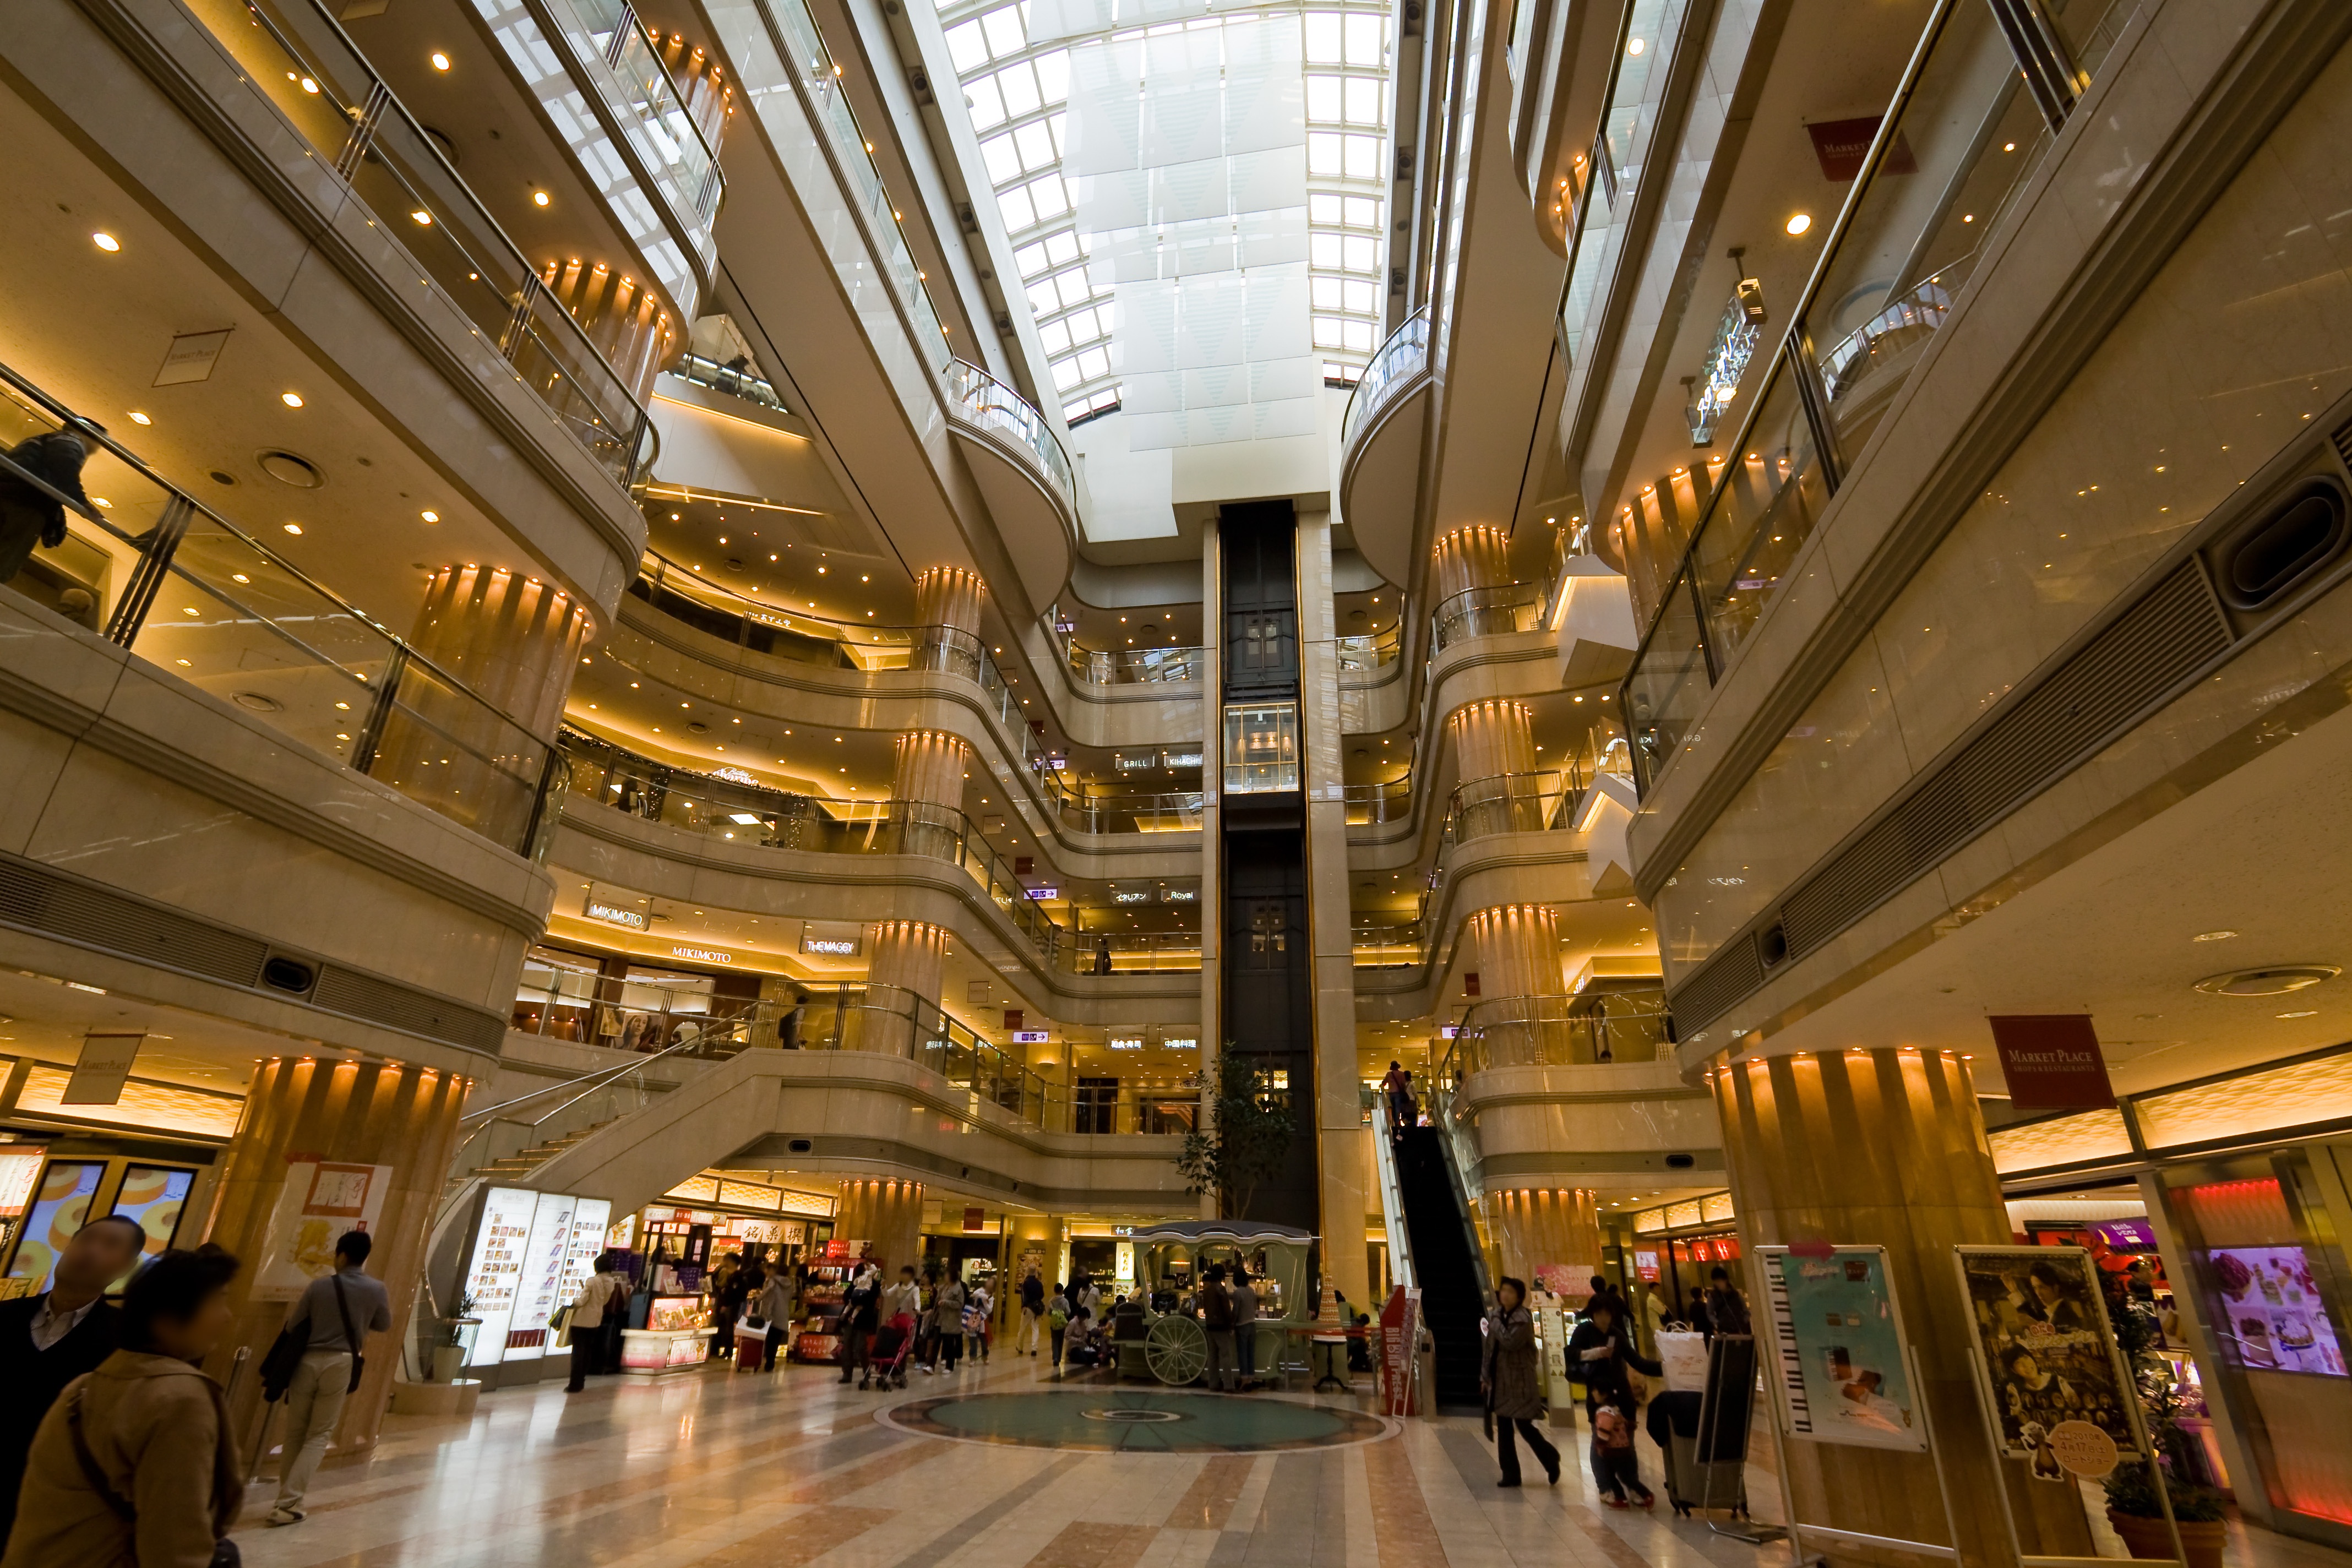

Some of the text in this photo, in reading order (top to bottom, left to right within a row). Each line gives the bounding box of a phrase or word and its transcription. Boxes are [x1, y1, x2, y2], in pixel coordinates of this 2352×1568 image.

[592, 905, 643, 925] MIKIMOTO
[672, 946, 731, 963] MIKIMOTO
[1164, 1039, 1196, 1048] 中国料理
[2008, 1049, 2093, 1063] MARKET PLACE
